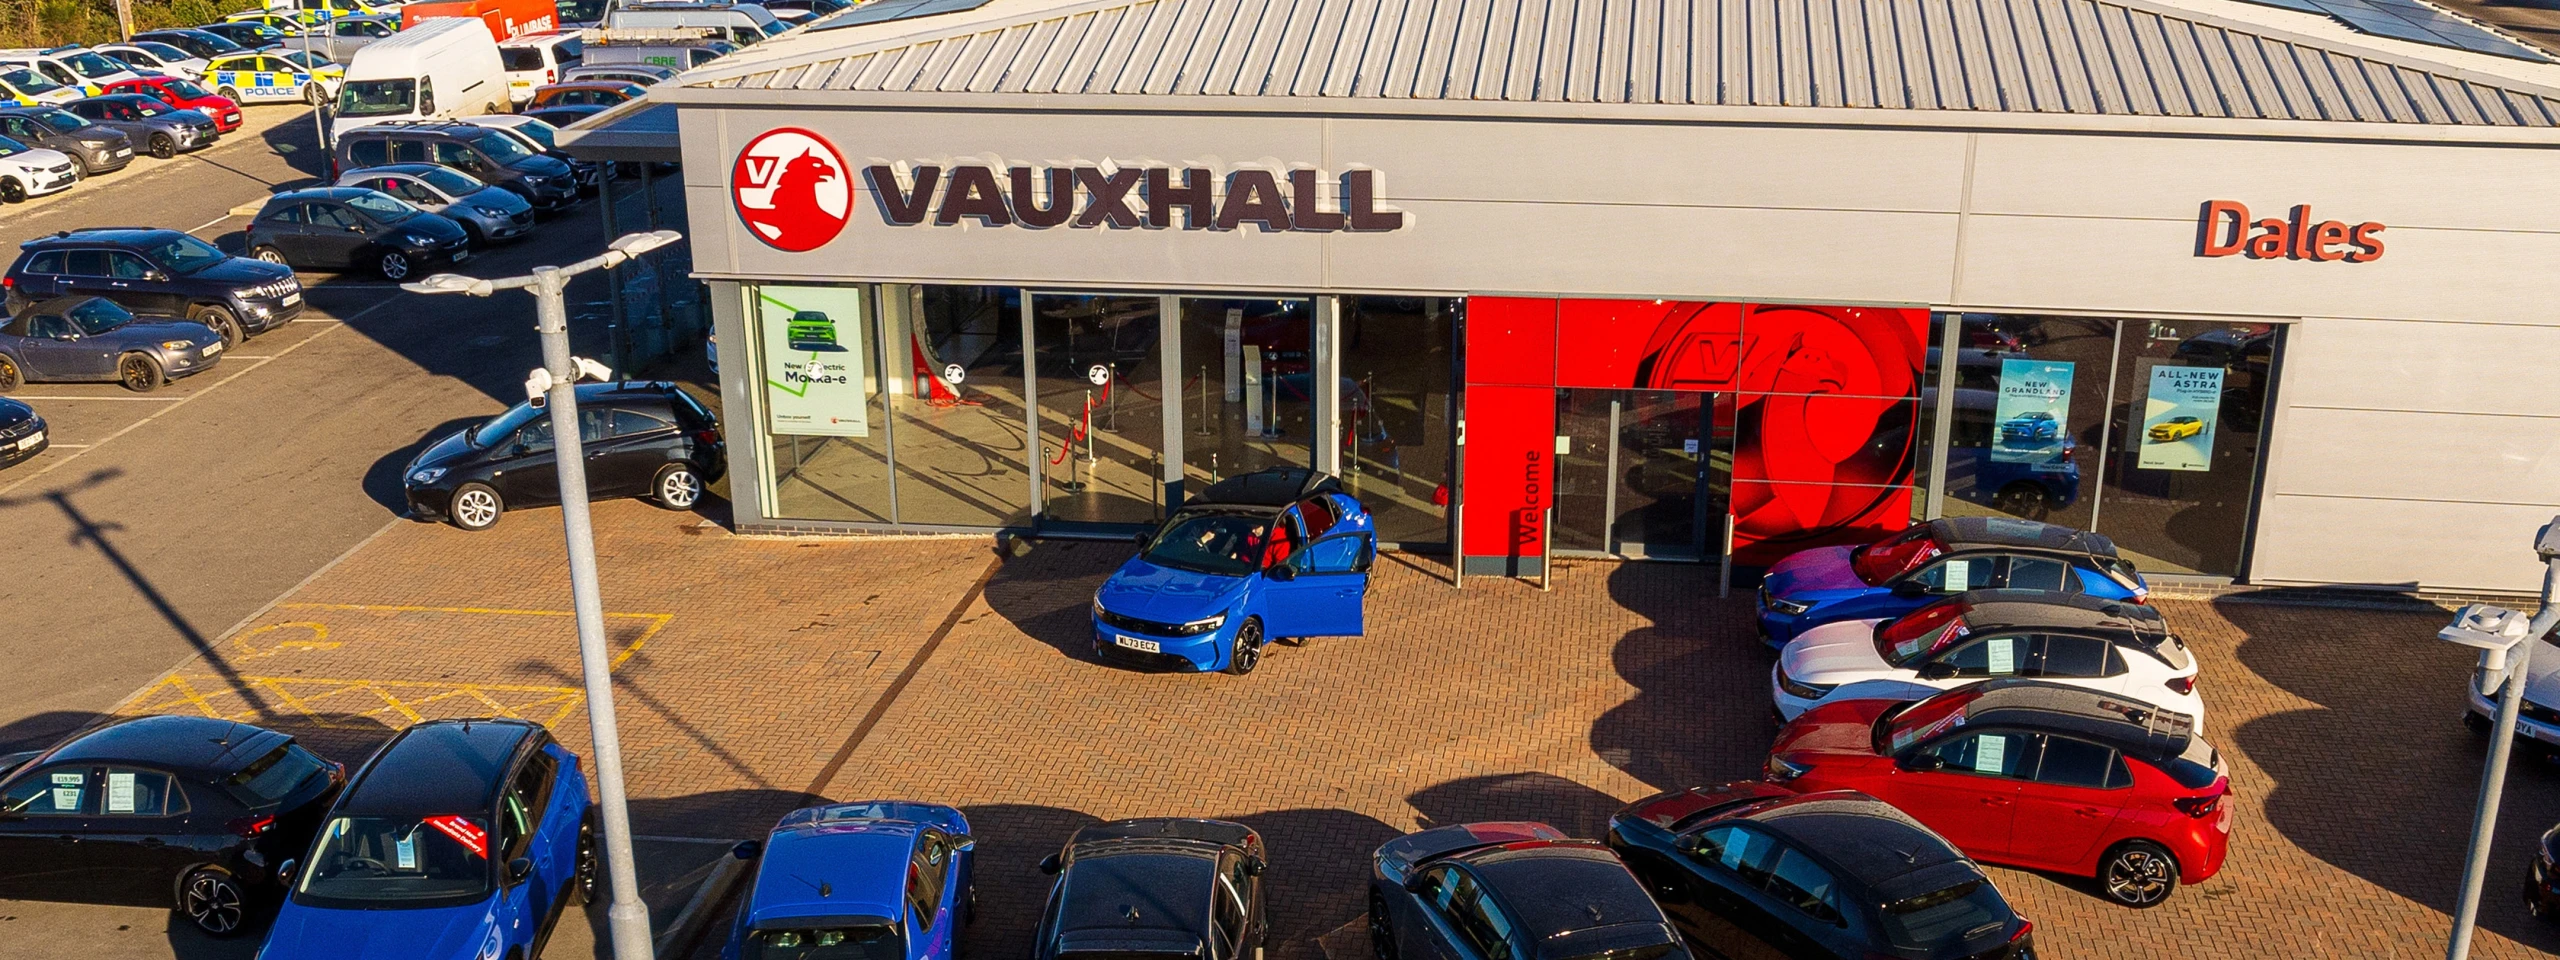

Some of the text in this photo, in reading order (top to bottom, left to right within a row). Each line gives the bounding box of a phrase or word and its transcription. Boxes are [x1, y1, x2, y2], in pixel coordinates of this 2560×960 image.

[643, 56, 677, 67] CBRE
[244, 87, 296, 97] POLICE
[864, 163, 1403, 232] VAUXHALL
[2196, 199, 2386, 263] Dales
[784, 362, 802, 370] New
[2158, 370, 2219, 380] ALL-NEW
[2024, 380, 2048, 388] NEW
[2173, 380, 2217, 389] ASTRA
[2004, 386, 2066, 396] GRANDLAND
[1519, 449, 1540, 546] Welcome
[1140, 640, 1157, 651] ECZ
[433, 819, 462, 838] Immediate
[460, 835, 482, 852] Delivery
[449, 820, 466, 832] Brand
[465, 829, 479, 840] New
